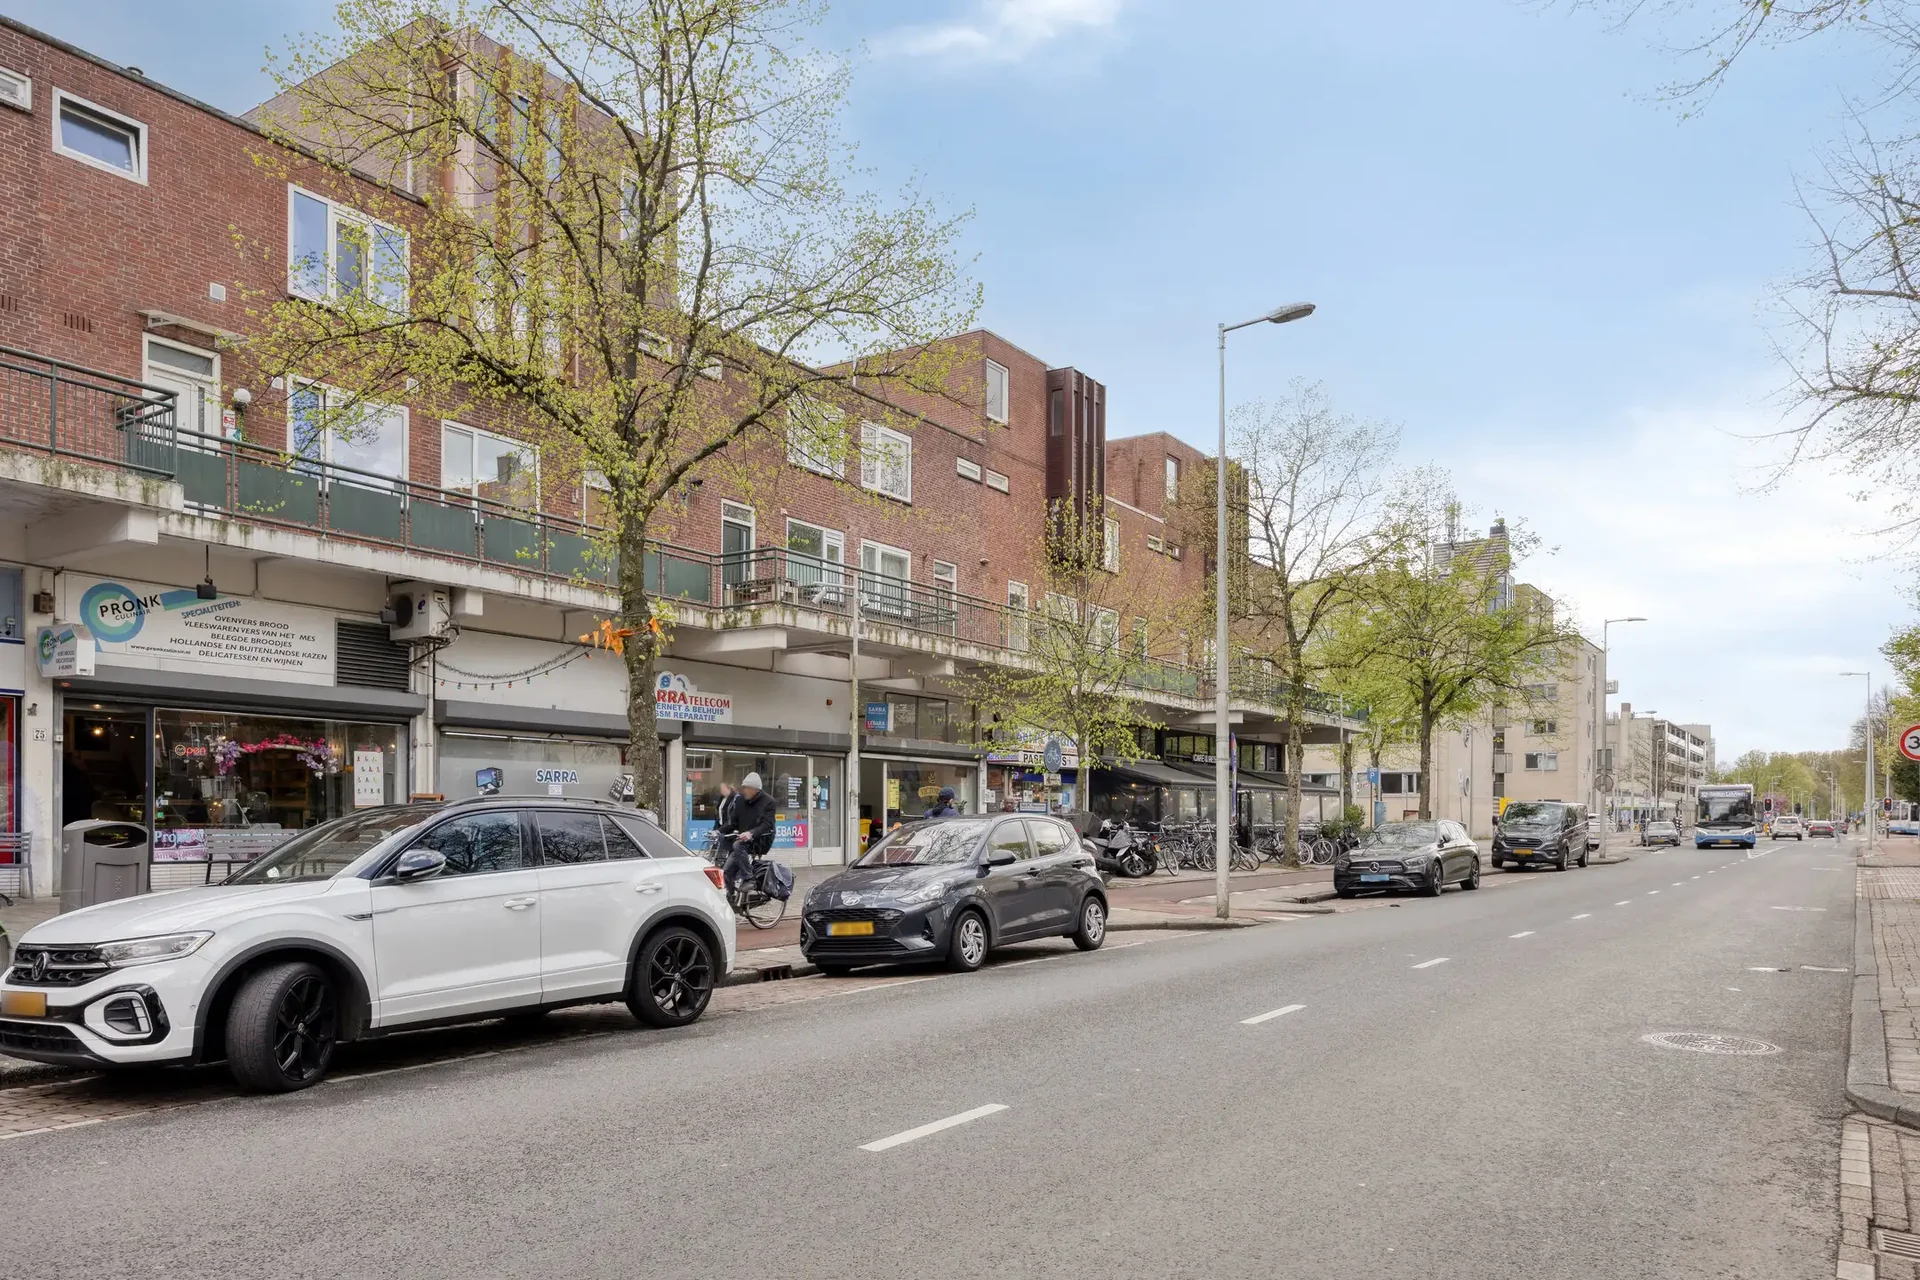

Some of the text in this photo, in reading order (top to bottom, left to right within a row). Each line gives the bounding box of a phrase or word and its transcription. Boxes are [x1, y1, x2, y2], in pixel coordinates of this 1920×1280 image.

[99, 594, 161, 617] PRONK
[181, 600, 241, 619] SPECIALITEITEN:
[115, 609, 151, 621] CULINAIR
[214, 615, 289, 630] OVENVERS BROOD
[184, 621, 240, 633] VLEESWAREN
[241, 628, 260, 636] VERS
[279, 632, 296, 640] HET
[299, 634, 316, 642] MES
[210, 633, 293, 648] BELEGDE BROODJES
[130, 645, 191, 655] www.pronkculinair.nl
[169, 637, 327, 660] HOLLANDSE EN BUITENLANDSE KAZEN
[198, 650, 259, 662] DELICATESSEN
[273, 657, 304, 667] WIJNEN
[656, 689, 730, 708] RRA TELECOM
[656, 703, 682, 712] ERNET
[692, 705, 725, 716] BELHUIS
[673, 711, 716, 722] REPARATIE
[35, 729, 45, 740] 75
[1908, 736, 1920, 750] 3
[536, 769, 579, 784] SARRA
[775, 825, 804, 837] EBARA
